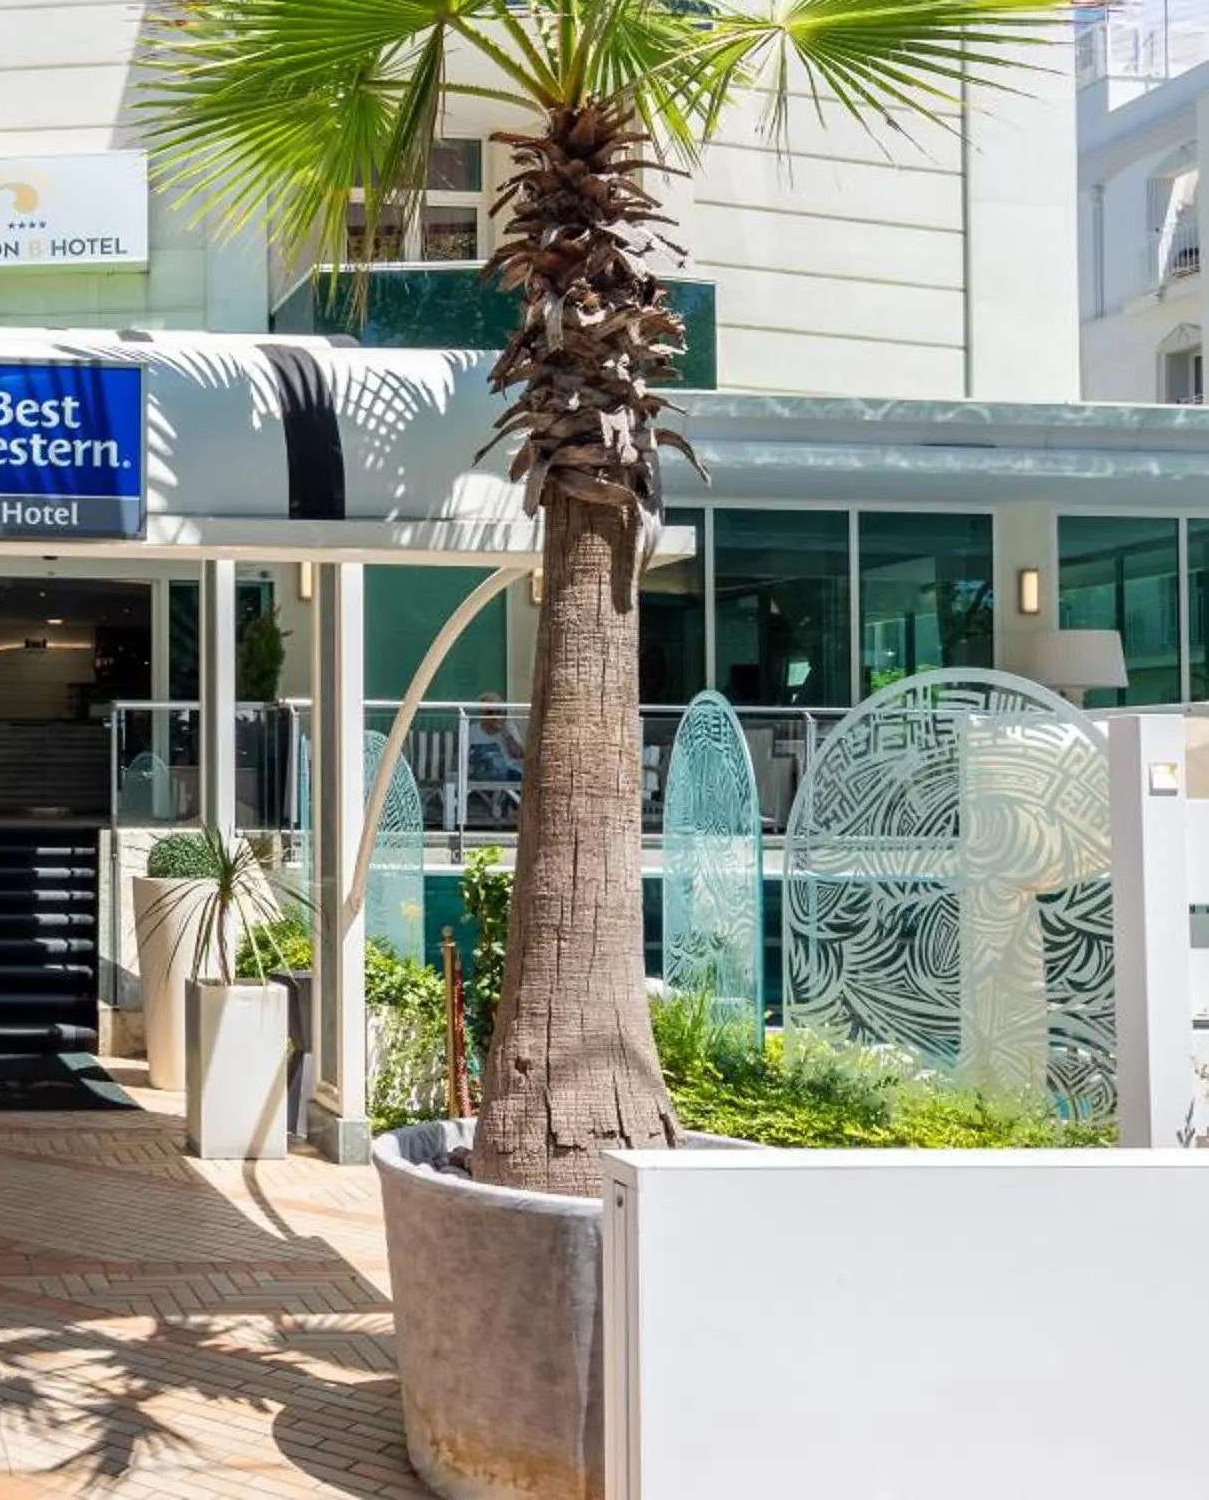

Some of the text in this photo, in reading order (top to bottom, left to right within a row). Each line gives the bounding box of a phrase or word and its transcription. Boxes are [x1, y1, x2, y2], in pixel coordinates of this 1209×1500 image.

[28, 239, 42, 258] B
[51, 237, 128, 257] HOTEL
[2, 502, 79, 526] Hotel
